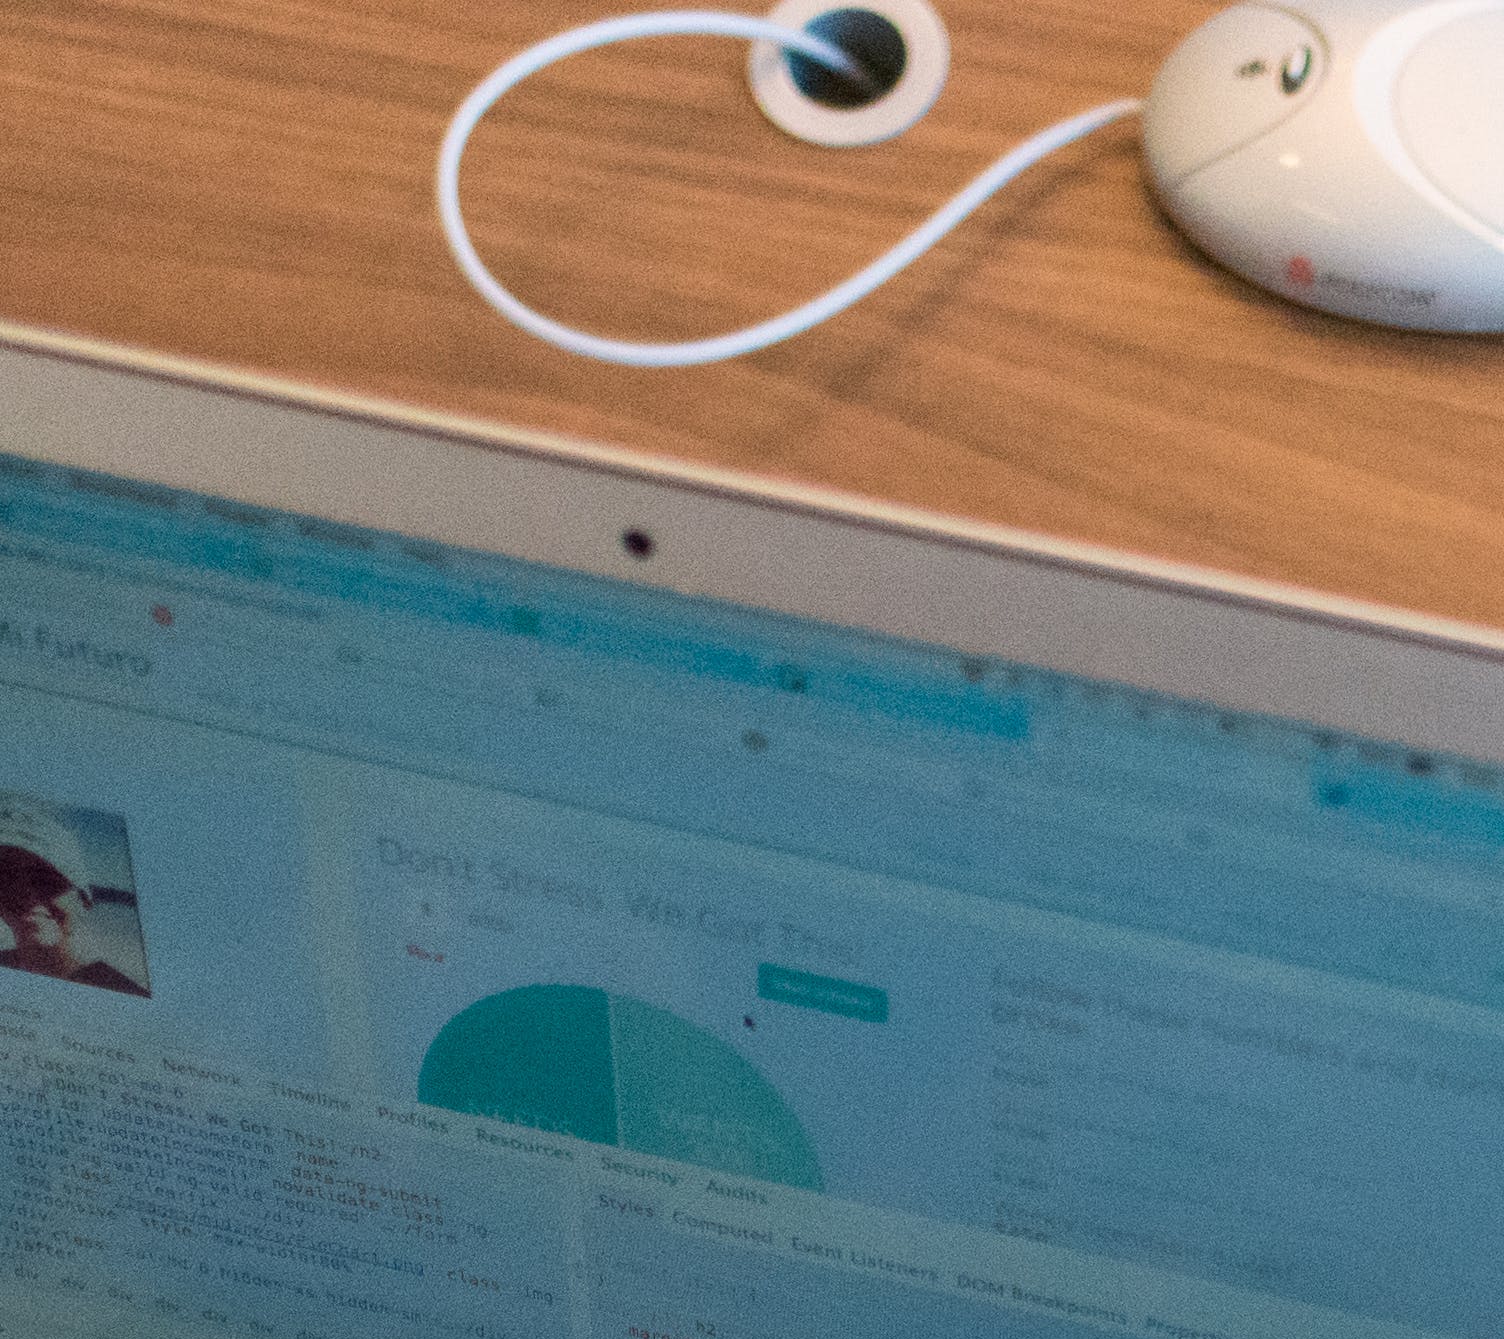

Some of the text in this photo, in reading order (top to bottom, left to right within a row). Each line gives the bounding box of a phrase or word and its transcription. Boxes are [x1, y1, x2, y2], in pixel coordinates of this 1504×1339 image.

[33, 629, 155, 680] Futuro
[375, 834, 478, 887] Don't
[60, 1034, 138, 1068] Sources
[160, 1056, 245, 1091] Network
[268, 1081, 353, 1115] Timeline
[375, 1105, 451, 1136] Profiles
[474, 1126, 575, 1164] Resources
[599, 1155, 682, 1193] Security
[704, 1177, 770, 1209] Audits
[597, 1193, 657, 1224] Styles
[672, 1209, 775, 1251] Computed
[790, 1235, 844, 1264] Event
[849, 1247, 940, 1285] Listeners
[956, 1273, 1006, 1301] DOM
[1012, 1285, 1129, 1329] Breakpoints
